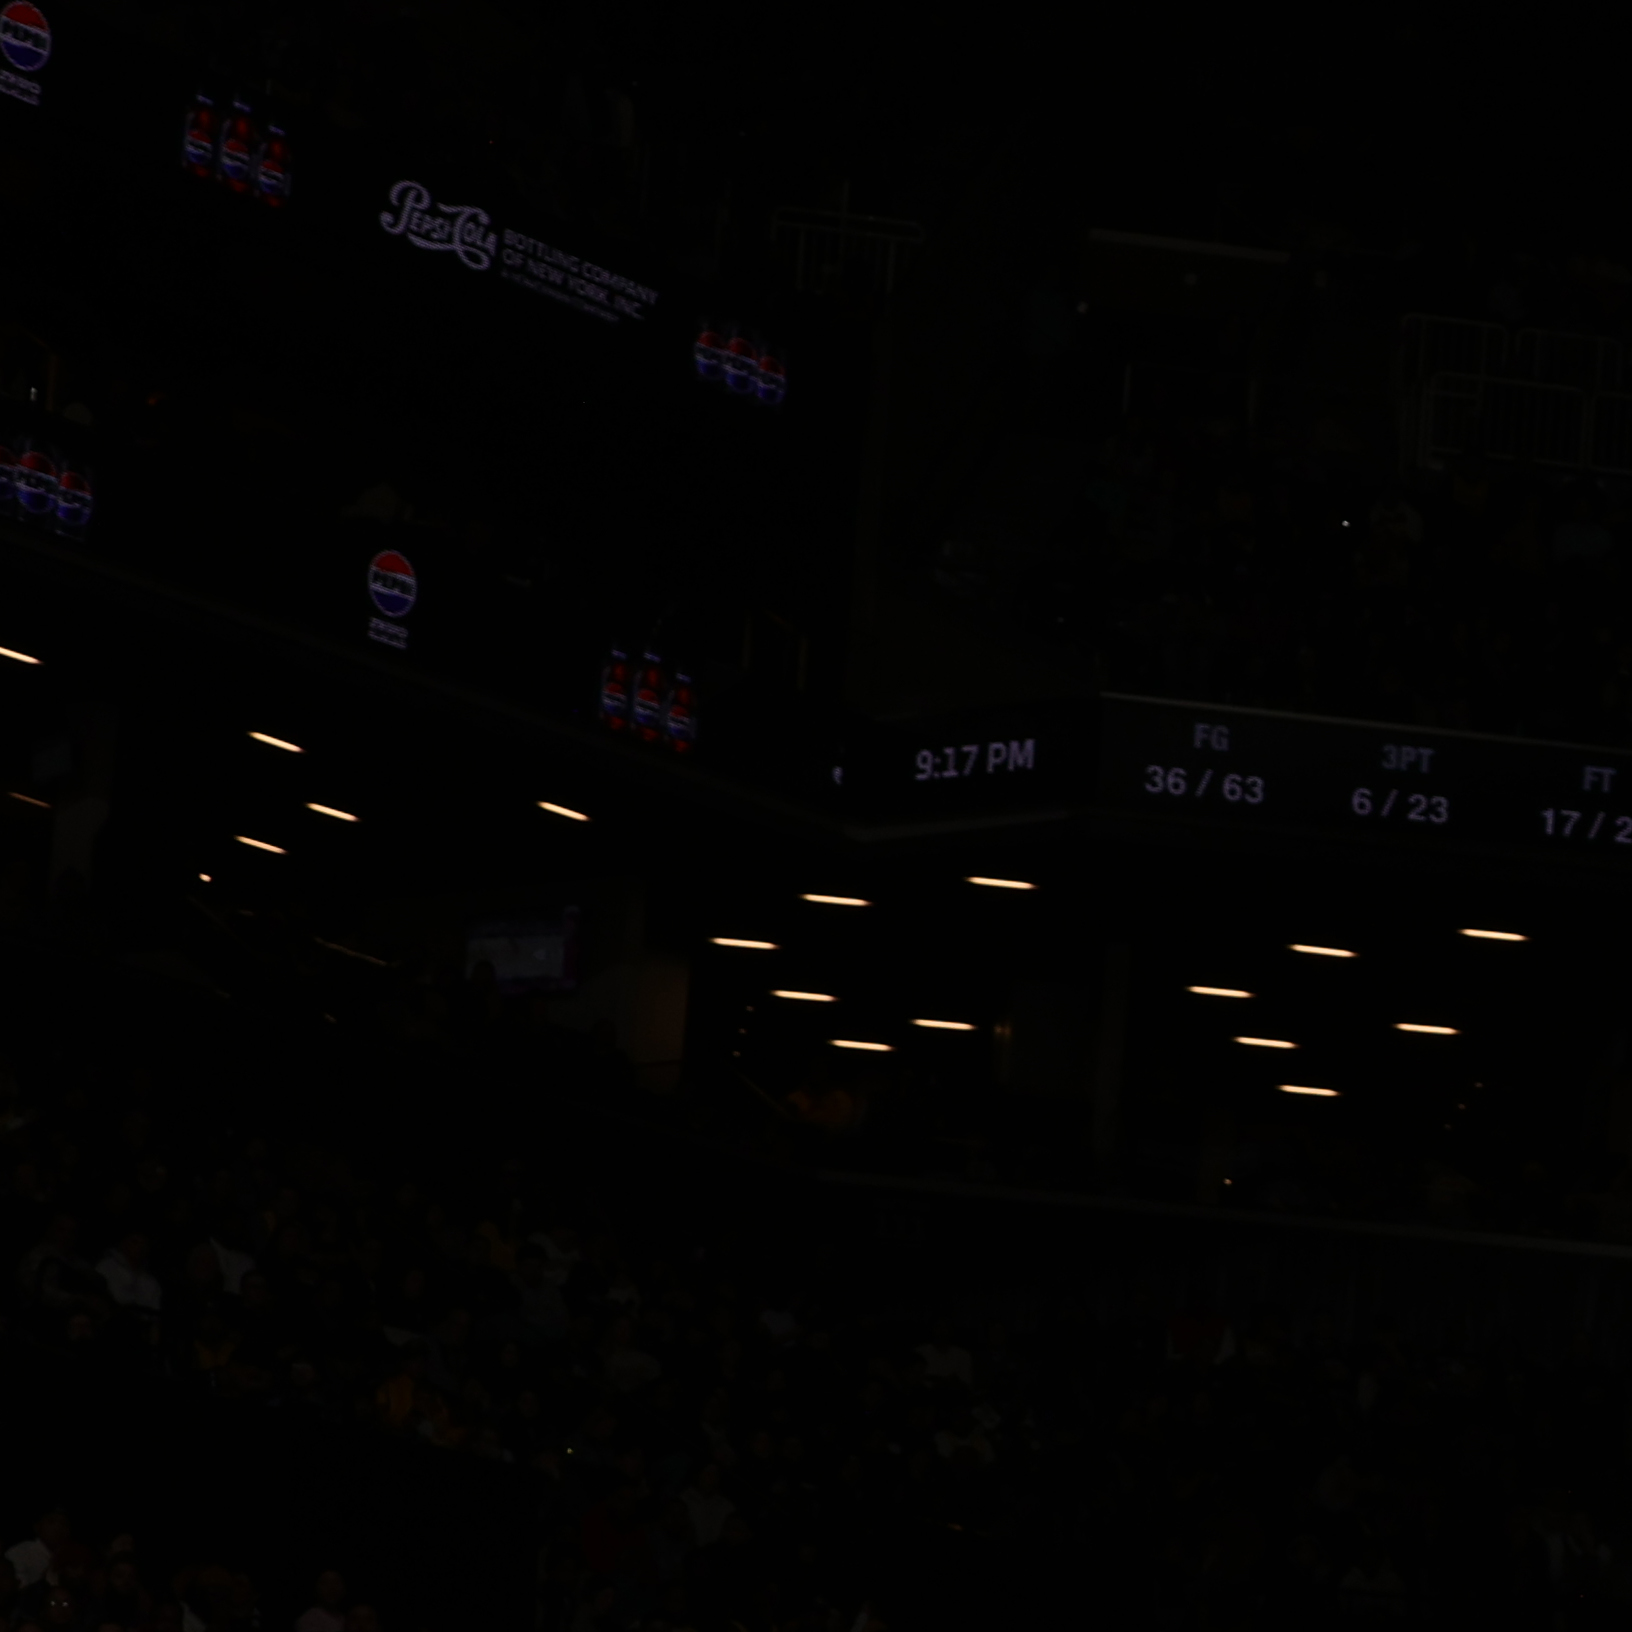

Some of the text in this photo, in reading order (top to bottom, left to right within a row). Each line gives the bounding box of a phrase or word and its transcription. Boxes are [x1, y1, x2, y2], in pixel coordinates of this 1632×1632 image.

[502, 248, 526, 268] OF
[1193, 722, 1230, 752] FG
[914, 738, 1037, 782] 9:17 PM
[1381, 743, 1436, 774] 3PT
[1144, 764, 1188, 796] 36
[1221, 773, 1266, 805] 63
[1581, 765, 1617, 794] FT
[1351, 786, 1374, 816] 6
[1406, 792, 1450, 825] 23
[1540, 807, 1582, 838] 17
